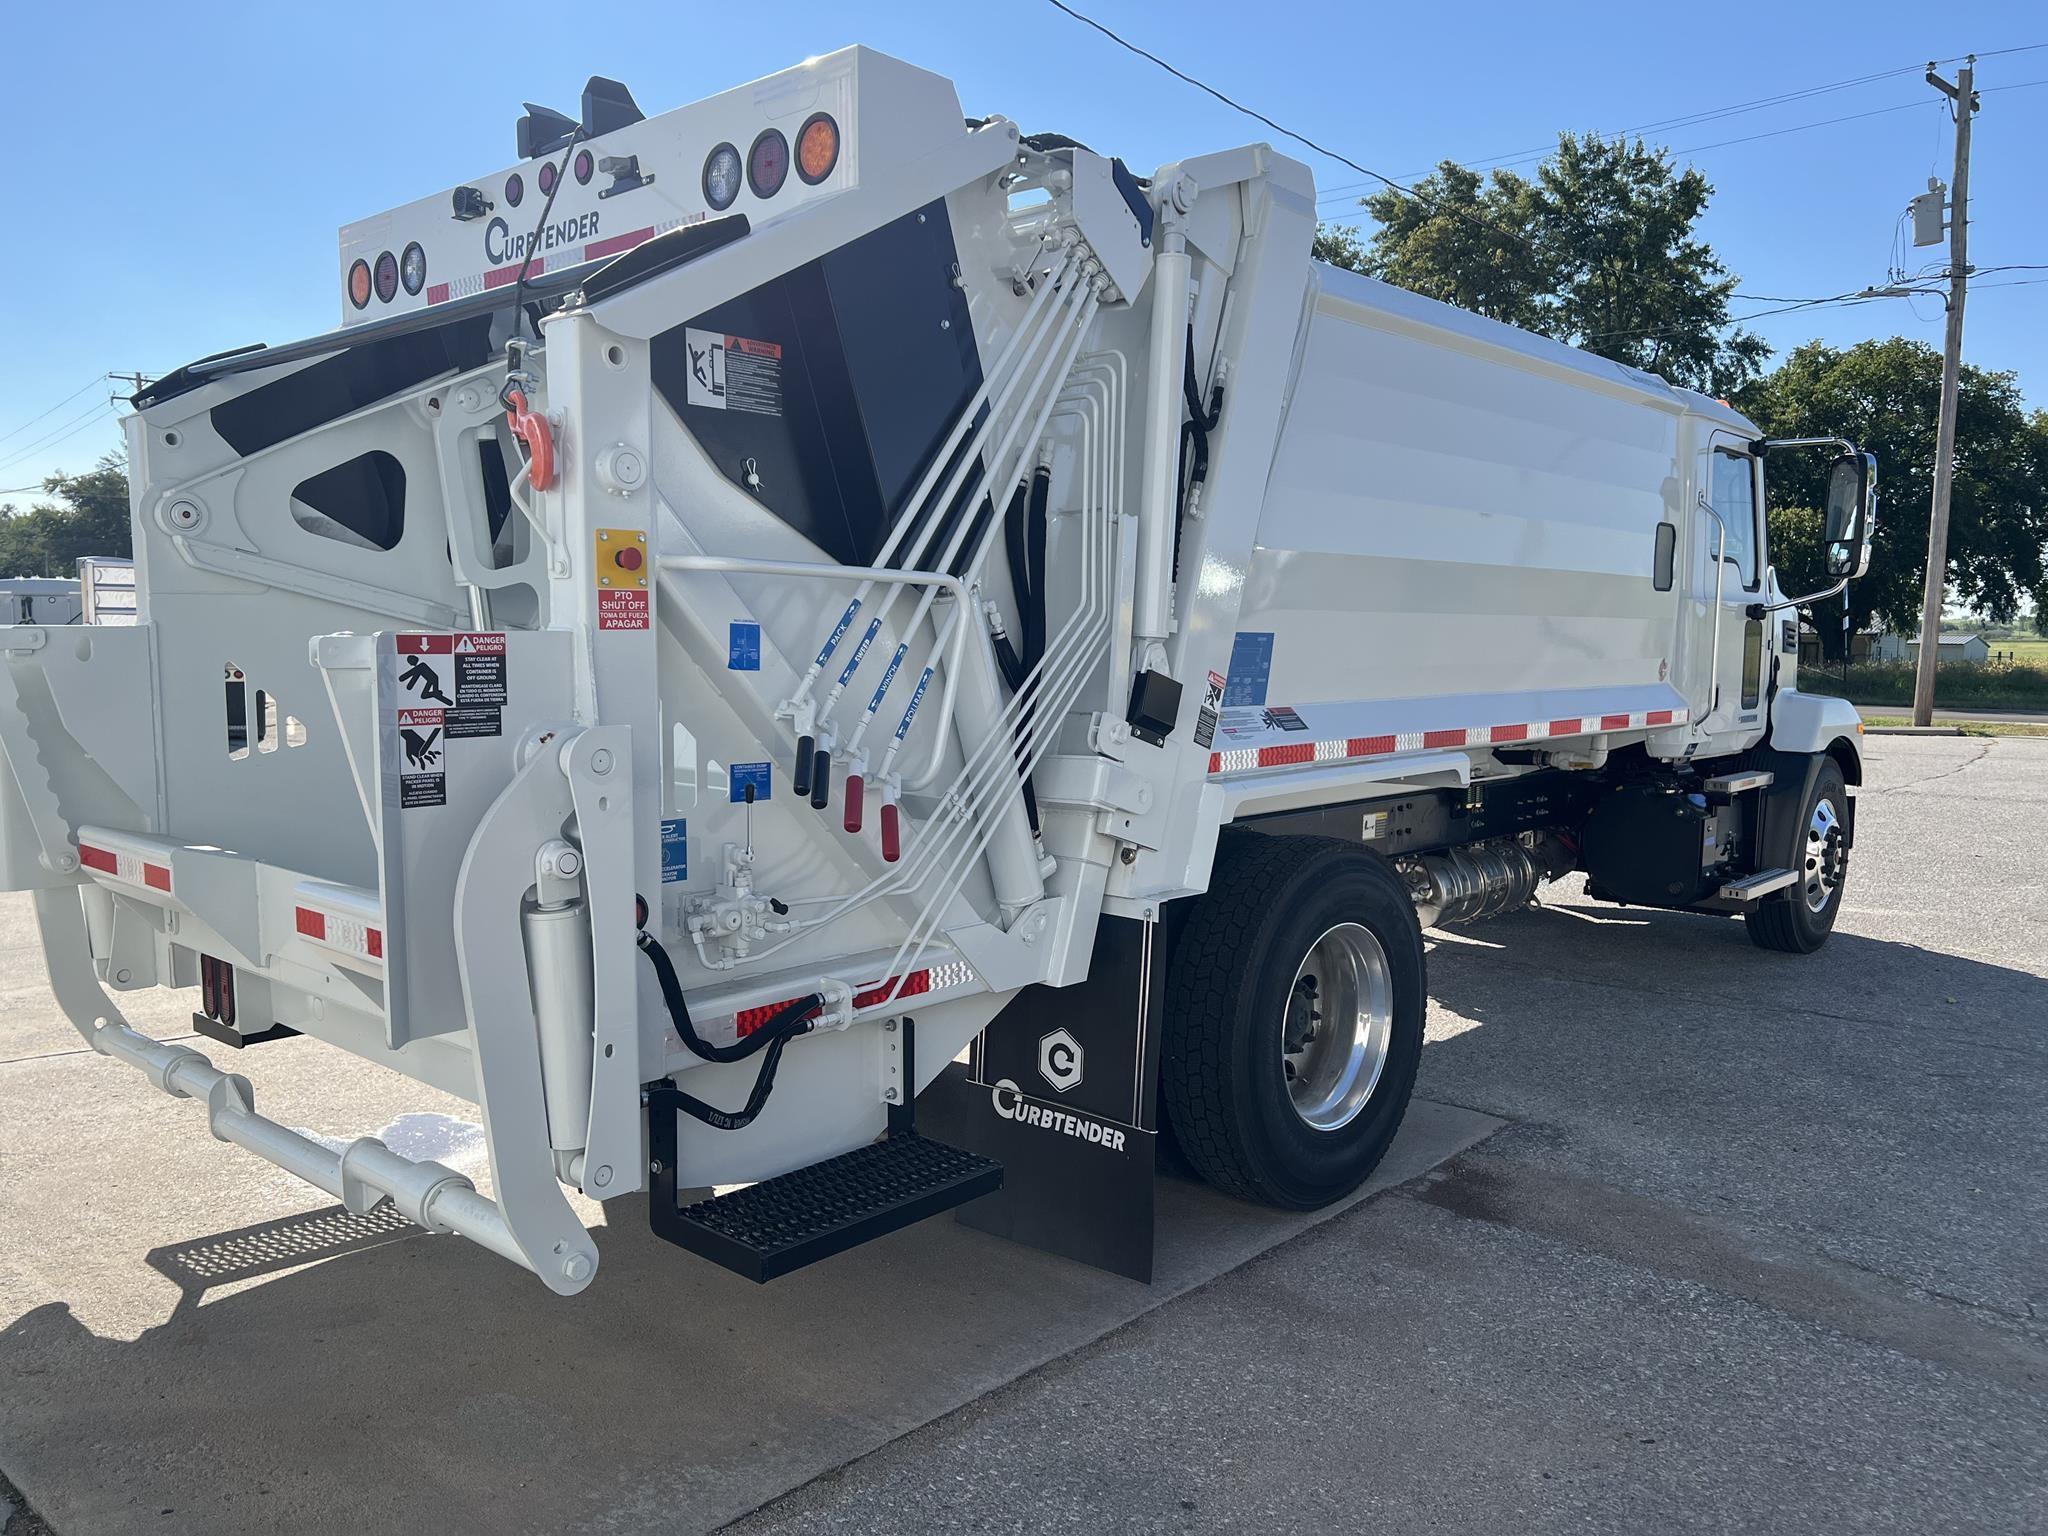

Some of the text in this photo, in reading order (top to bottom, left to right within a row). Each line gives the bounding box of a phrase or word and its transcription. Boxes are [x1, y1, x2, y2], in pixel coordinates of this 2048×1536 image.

[614, 592, 633, 600] PTO
[601, 601, 645, 609] SHUT OFF
[606, 620, 643, 628] APAGAR
[473, 636, 505, 645] DANGER
[830, 623, 847, 645] PACK
[855, 639, 870, 662] SWEEP
[880, 665, 897, 691] WINCH
[413, 709, 442, 717] DANGER
[905, 688, 925, 723] ROLLBAR
[992, 1078, 1126, 1152] CURBTENDER
